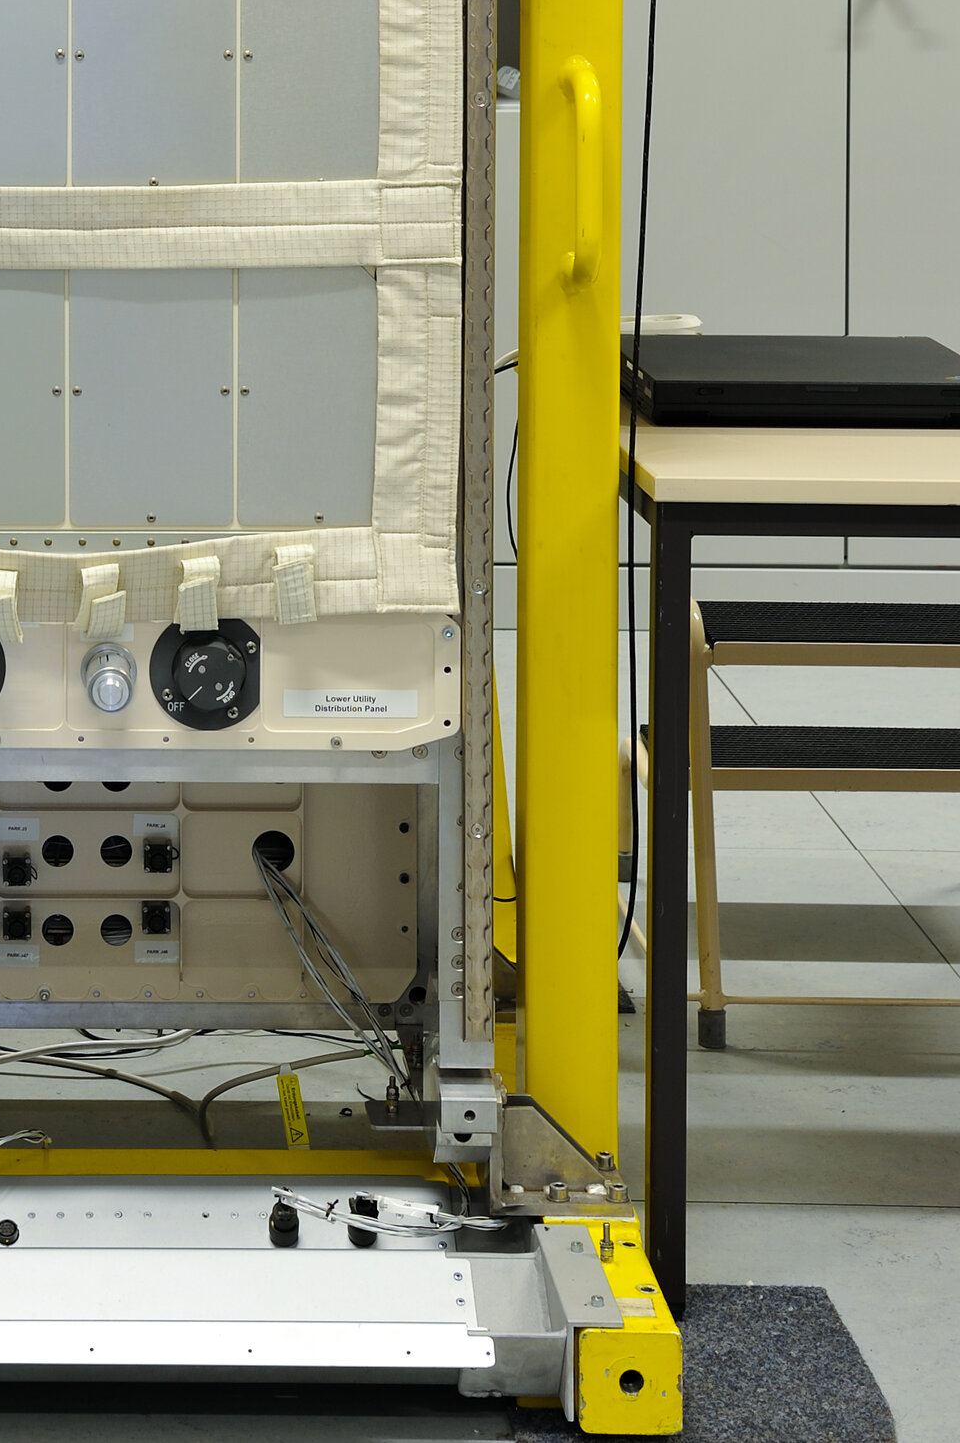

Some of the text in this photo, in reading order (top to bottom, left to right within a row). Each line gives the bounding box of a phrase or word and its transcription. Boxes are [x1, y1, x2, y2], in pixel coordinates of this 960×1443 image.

[184, 652, 200, 668] CLOSE
[222, 690, 236, 704] OPEN
[325, 695, 377, 704] Lower Utility
[167, 701, 185, 712] OFF
[314, 704, 388, 713] Distribution Panel
